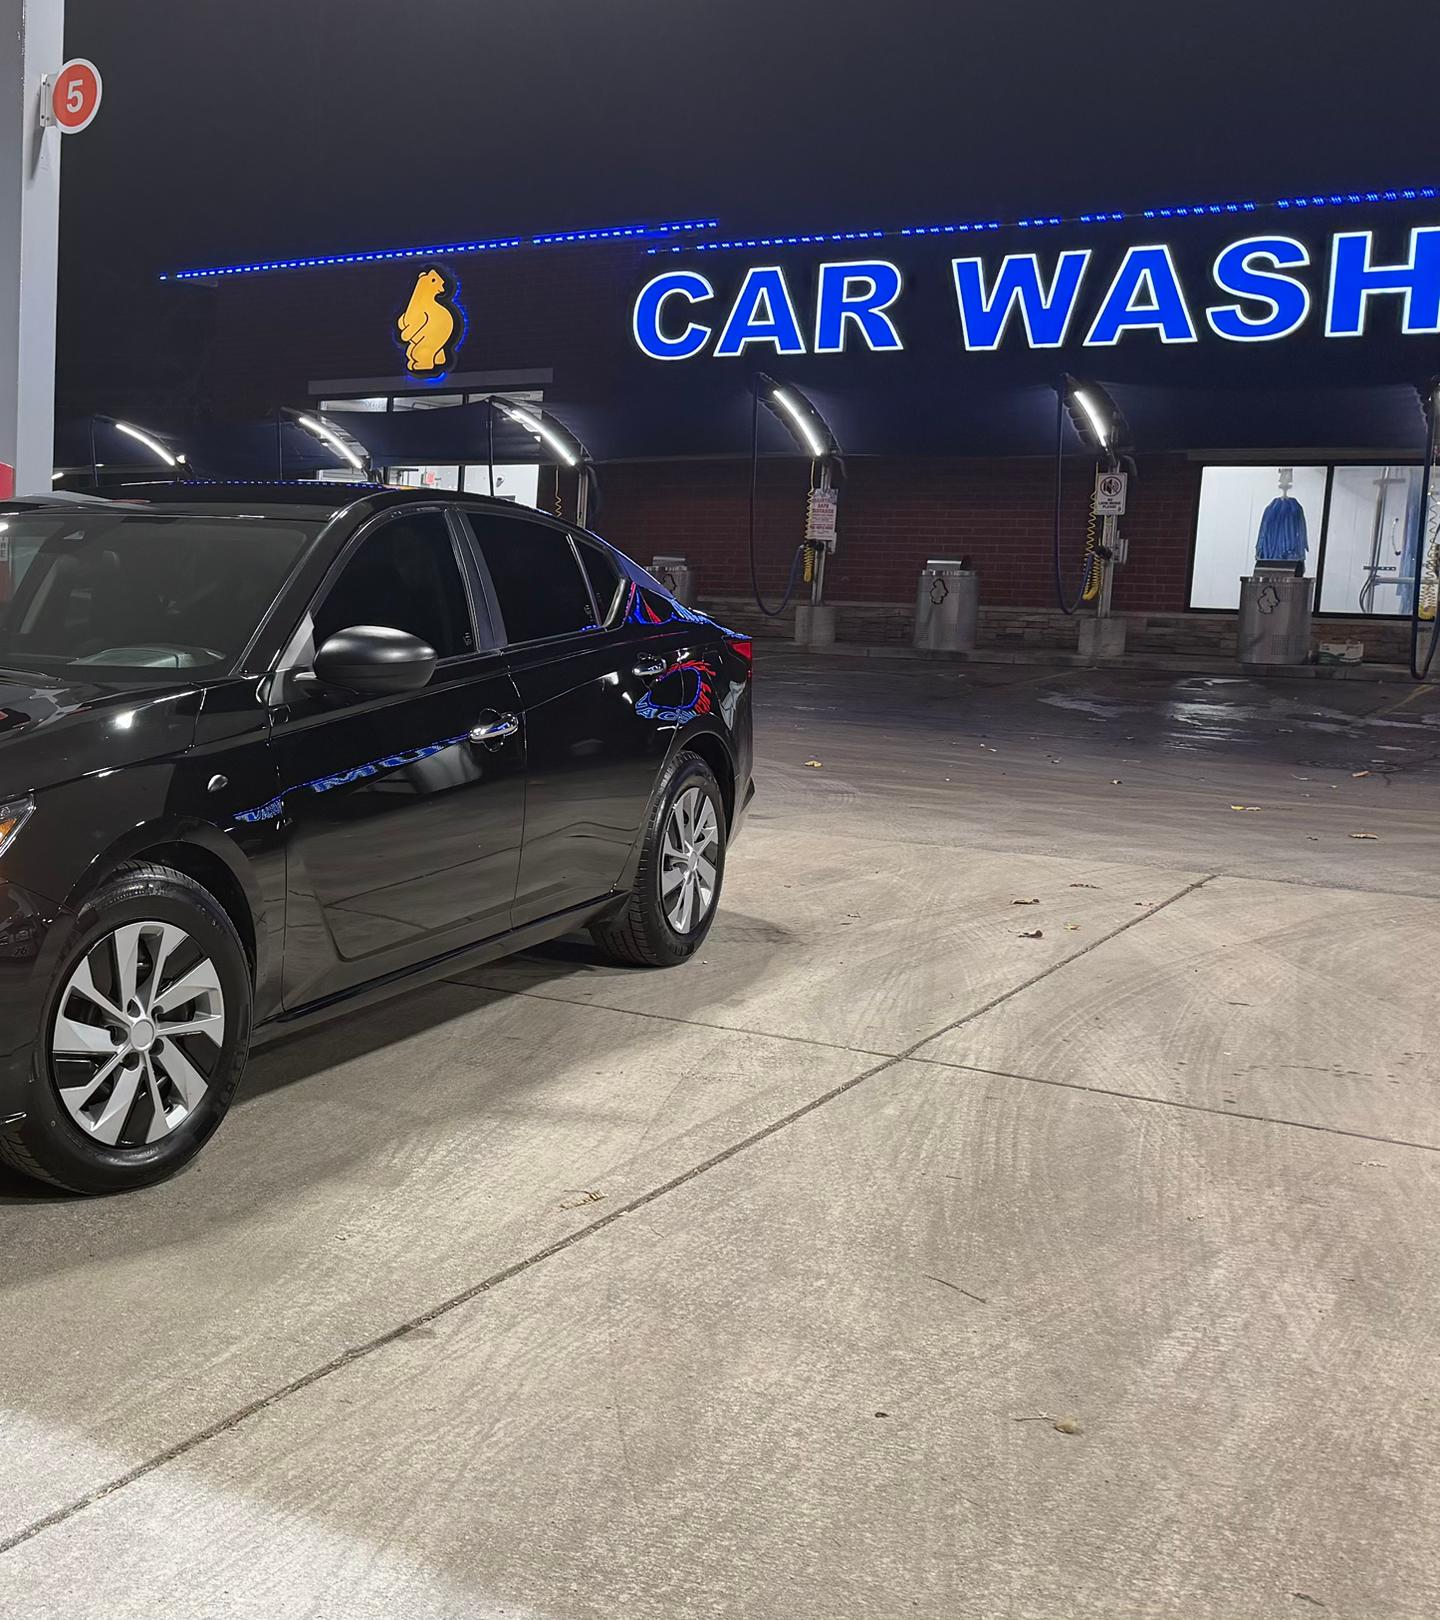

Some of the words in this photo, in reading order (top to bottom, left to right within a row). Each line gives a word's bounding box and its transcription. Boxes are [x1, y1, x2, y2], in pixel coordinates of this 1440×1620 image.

[66, 79, 84, 113] 5
[633, 260, 903, 361] CAR
[952, 226, 1440, 352] WASH
